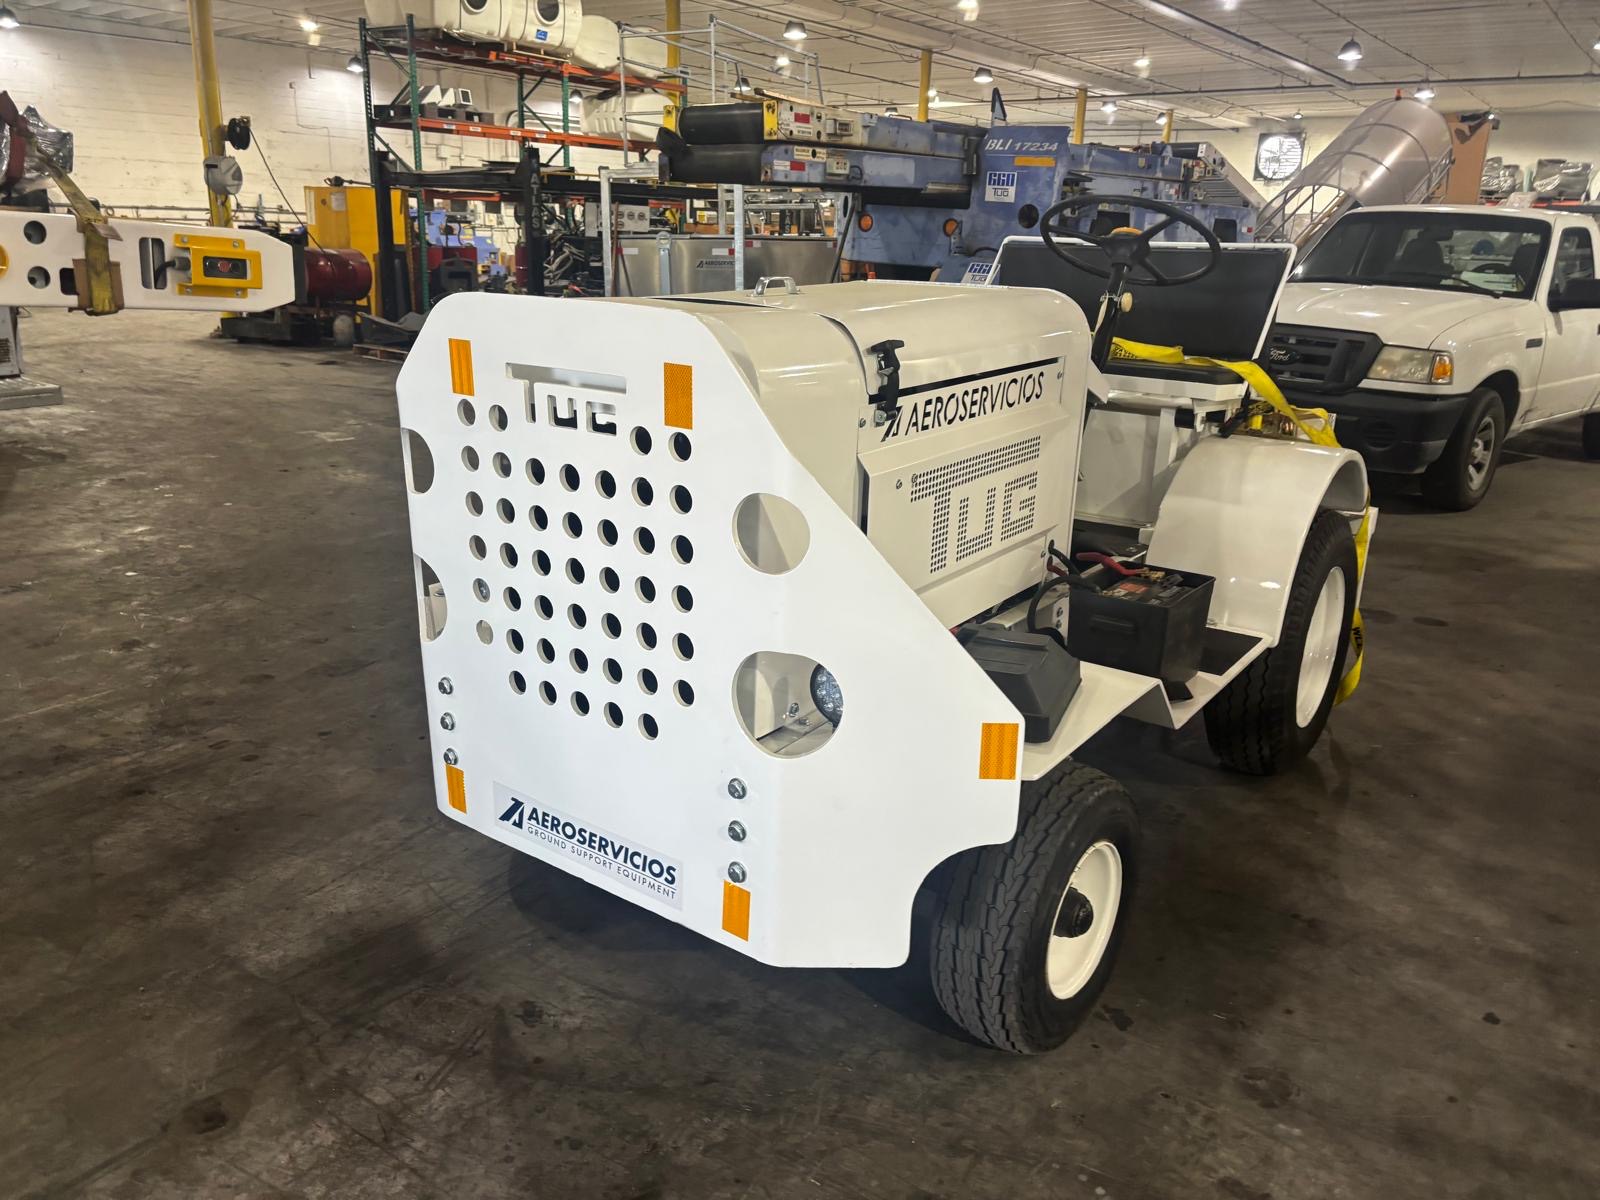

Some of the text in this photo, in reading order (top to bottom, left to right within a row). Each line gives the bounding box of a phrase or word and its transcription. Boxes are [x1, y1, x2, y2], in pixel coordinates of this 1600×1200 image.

[1014, 142, 1058, 152] 17234
[530, 172, 540, 228] ATLAS
[992, 187, 1009, 197] TUG
[1270, 348, 1290, 361] Ford
[505, 362, 627, 437] TUG
[905, 371, 1045, 436] AEROSERVICIOS
[911, 435, 1041, 574] TUG
[527, 807, 678, 885] AEROSERVICIOS
[528, 827, 677, 900] GROUND SUPPORT EQUIPMENT
